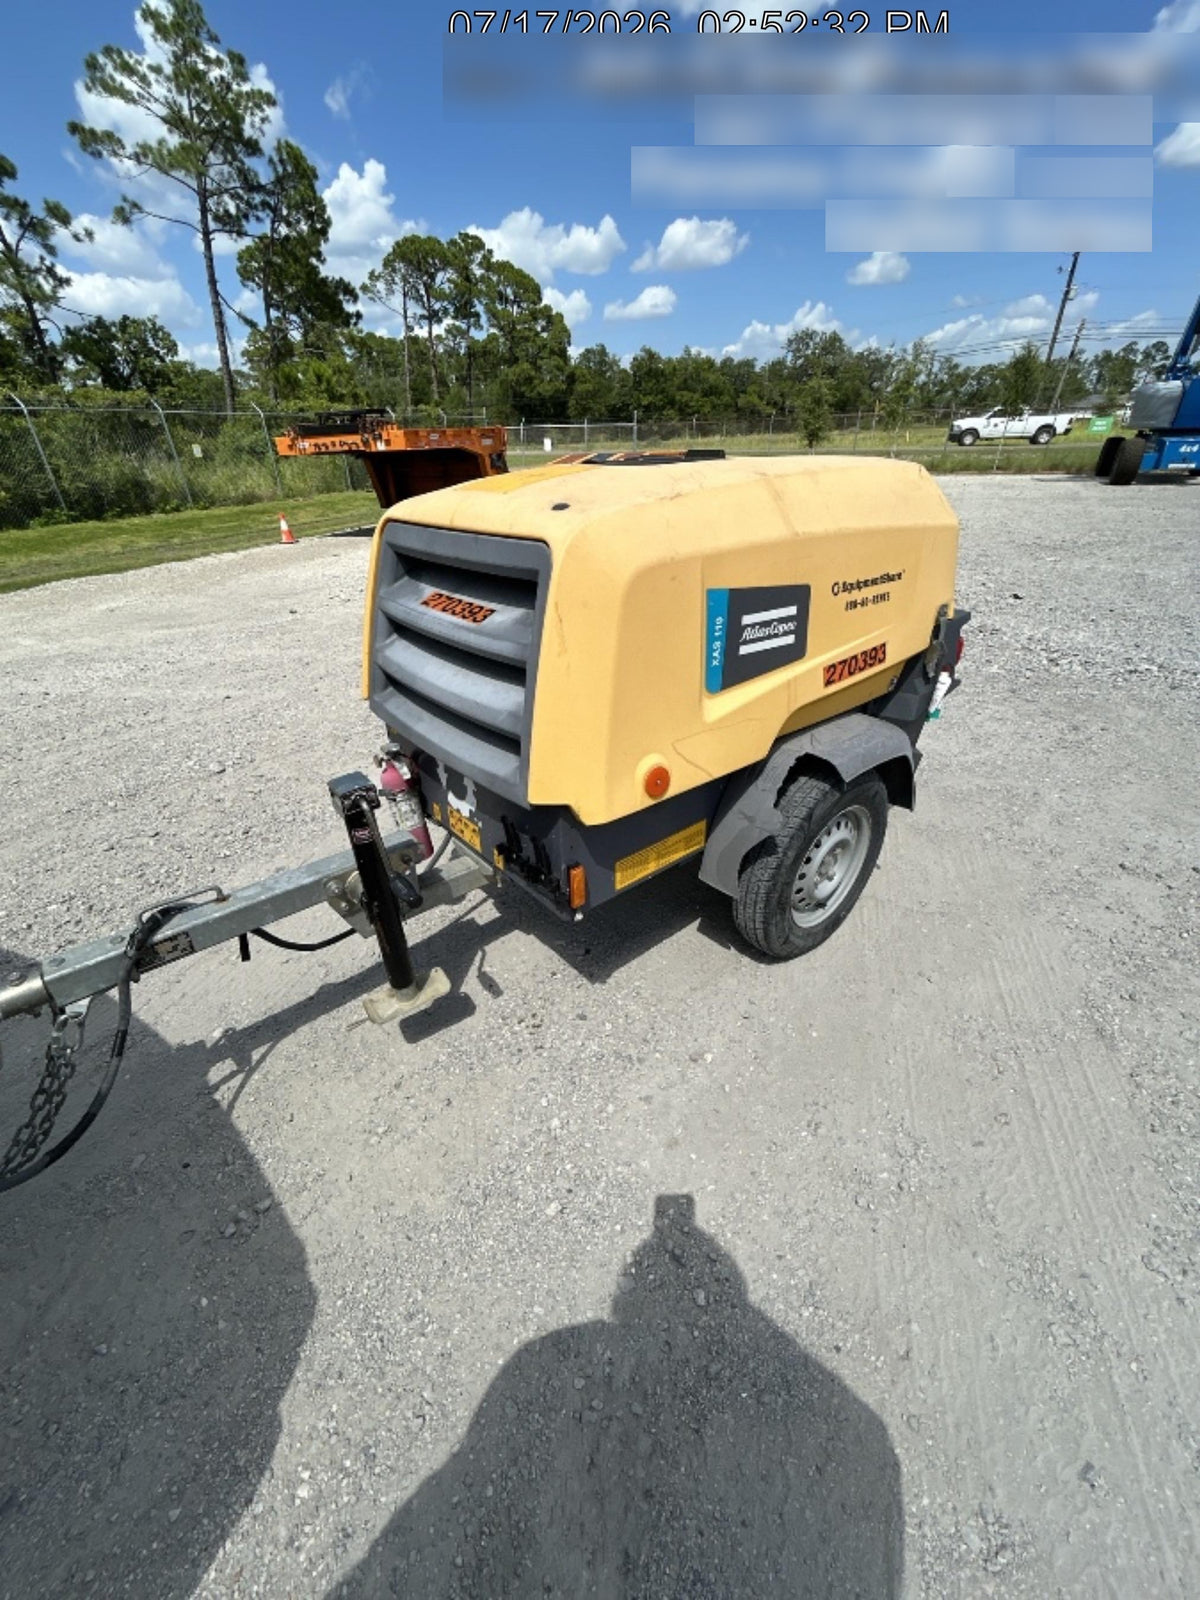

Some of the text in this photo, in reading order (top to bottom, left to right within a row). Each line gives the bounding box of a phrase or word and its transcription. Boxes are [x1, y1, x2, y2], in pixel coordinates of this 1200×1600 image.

[420, 592, 496, 624] 270393
[712, 640, 722, 667] XAS
[824, 641, 887, 688] 270393
